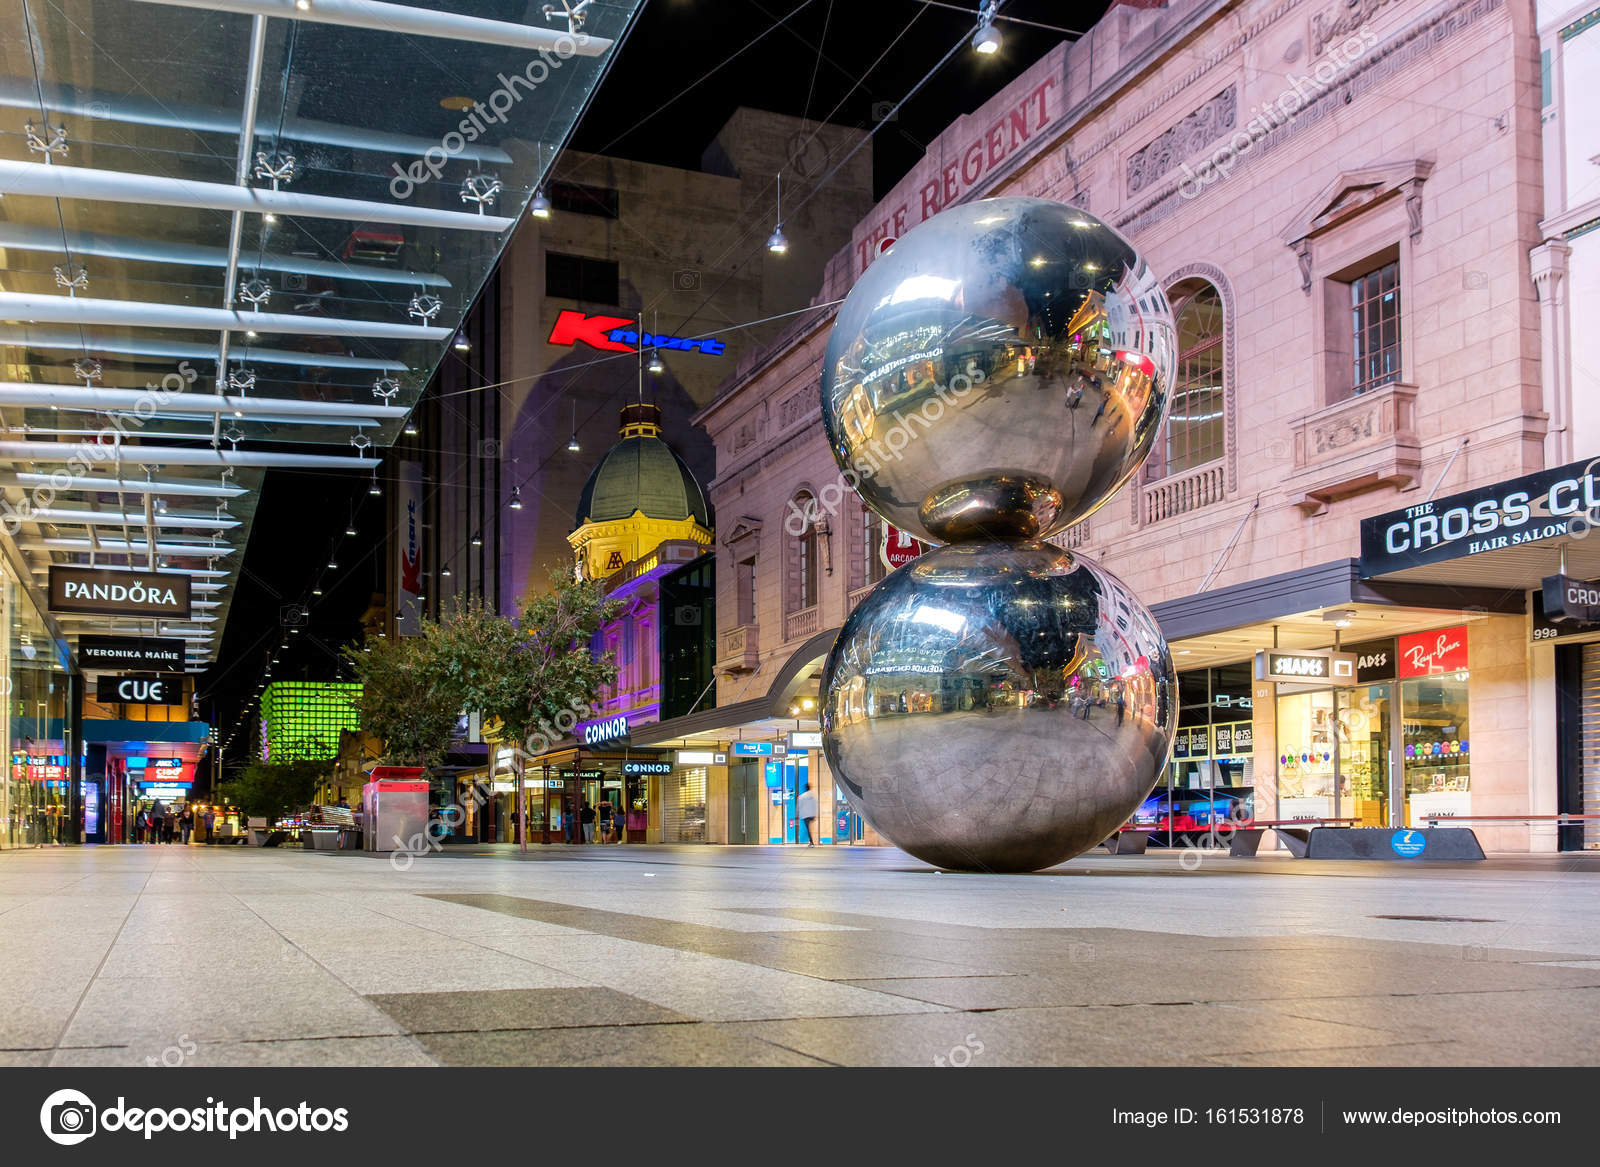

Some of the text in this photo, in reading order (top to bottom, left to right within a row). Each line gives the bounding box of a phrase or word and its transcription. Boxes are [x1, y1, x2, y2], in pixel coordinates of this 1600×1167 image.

[856, 76, 1055, 275] THE REGENT
[1405, 502, 1433, 519] THE
[1386, 492, 1530, 554] CROSS
[1469, 536, 1508, 554] HAIR
[1512, 521, 1568, 543] SALON
[64, 581, 178, 605] PANDORA
[1534, 628, 1558, 639] 99a
[86, 648, 179, 660] VERONIKA MAINE
[1357, 653, 1387, 669] ADES
[1404, 634, 1461, 669] Ray-Ban
[1275, 657, 1323, 675] SHADES
[118, 680, 162, 701] CUE
[585, 717, 627, 744] CONNOR
[624, 764, 670, 773] CONNOR
